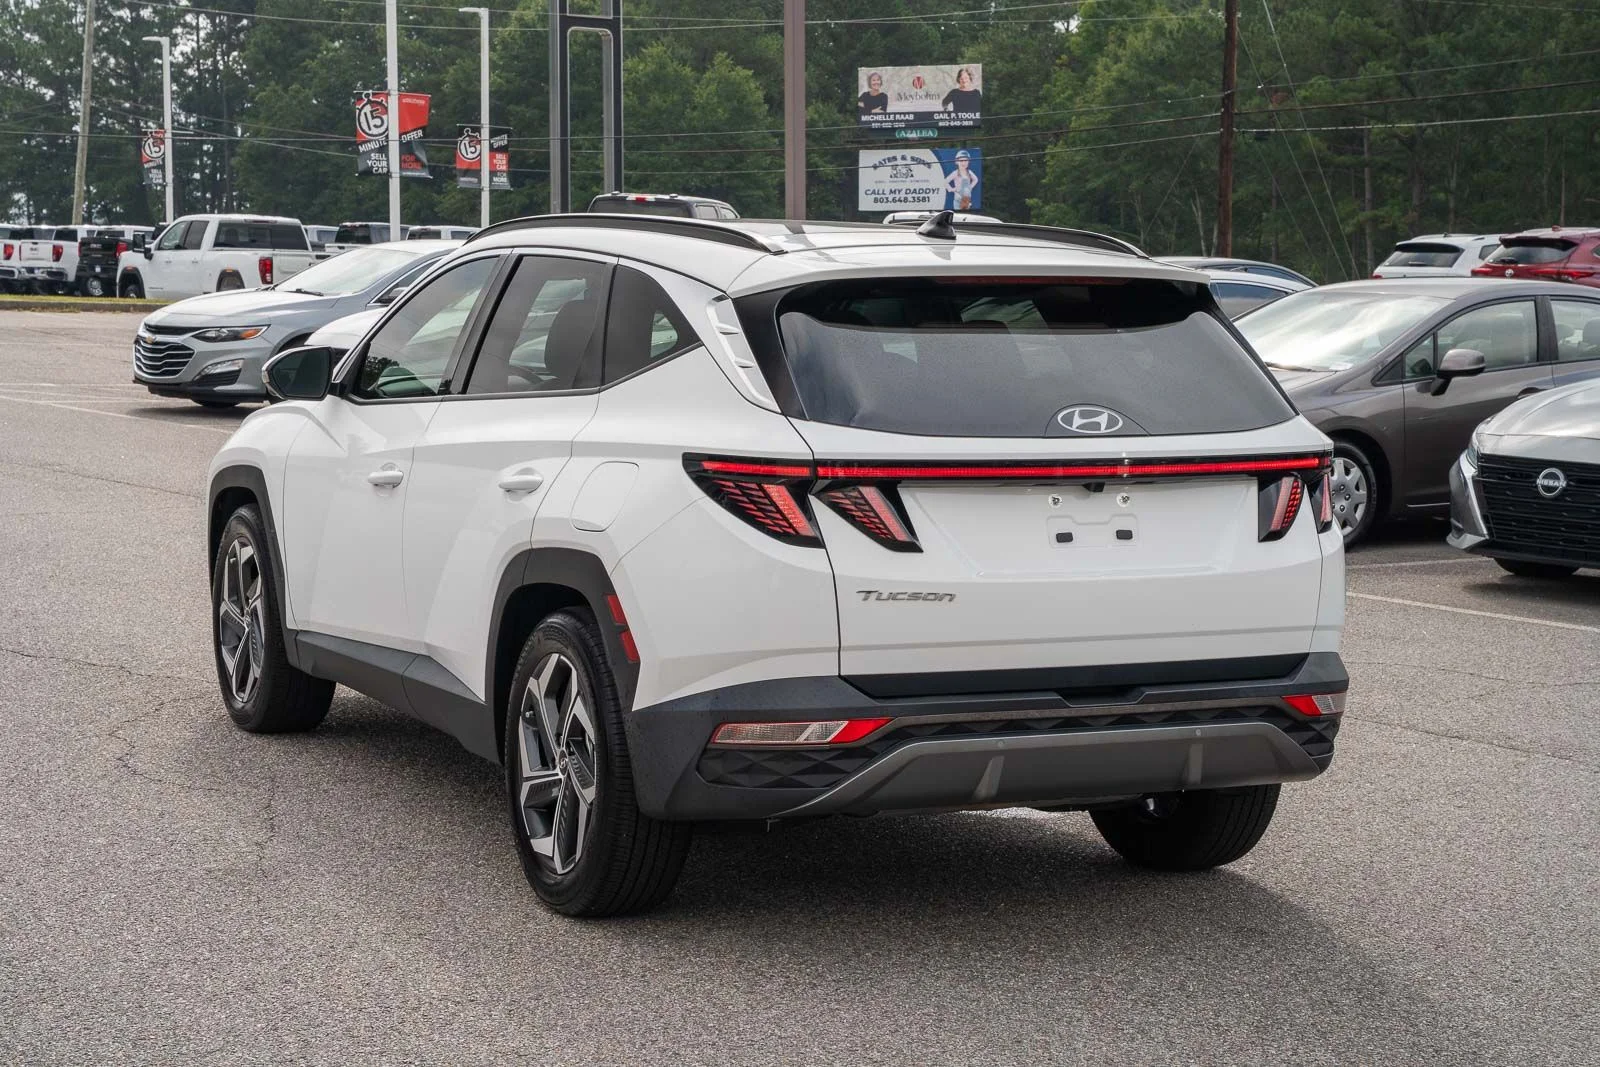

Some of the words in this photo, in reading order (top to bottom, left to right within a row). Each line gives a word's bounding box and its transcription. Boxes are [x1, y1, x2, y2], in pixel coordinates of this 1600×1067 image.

[363, 107, 385, 132] 15
[401, 129, 424, 143] OFFER
[899, 129, 934, 137] AZALEA
[358, 138, 388, 153] MINUTE
[463, 140, 477, 156] 15
[367, 160, 388, 168] YOUR
[864, 188, 886, 196] CALL
[888, 188, 903, 196] MY
[904, 187, 940, 195] DADDY!
